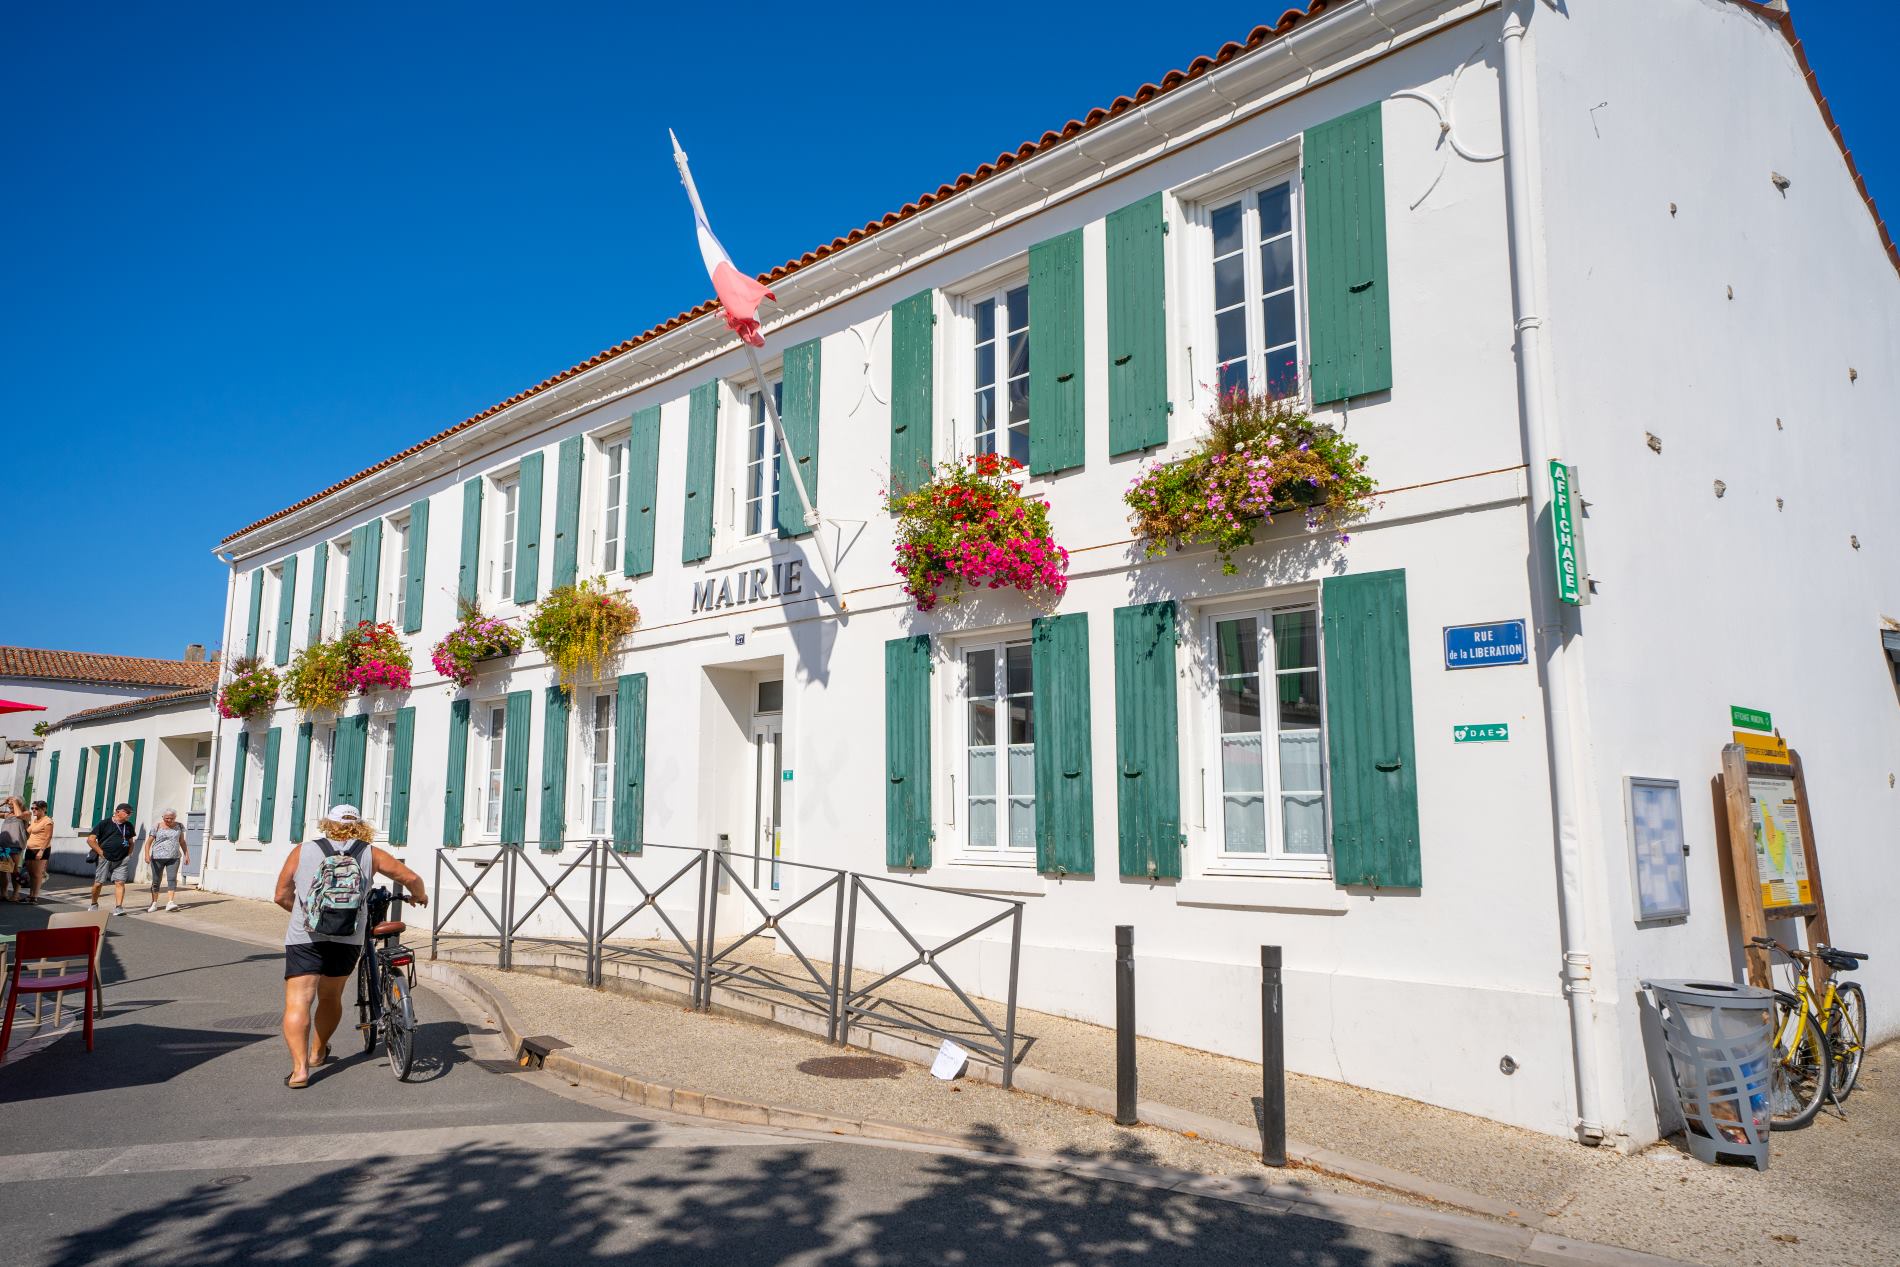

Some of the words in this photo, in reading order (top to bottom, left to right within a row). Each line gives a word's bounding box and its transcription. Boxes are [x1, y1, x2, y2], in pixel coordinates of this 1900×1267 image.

[1554, 466, 1575, 588] AFFICHAGE
[691, 559, 803, 614] MAIRIE
[1474, 630, 1494, 642] RUE
[1449, 651, 1458, 660] de
[1460, 649, 1468, 659] la
[1469, 644, 1522, 659] LIBERATION
[1470, 729, 1494, 737] DAE
